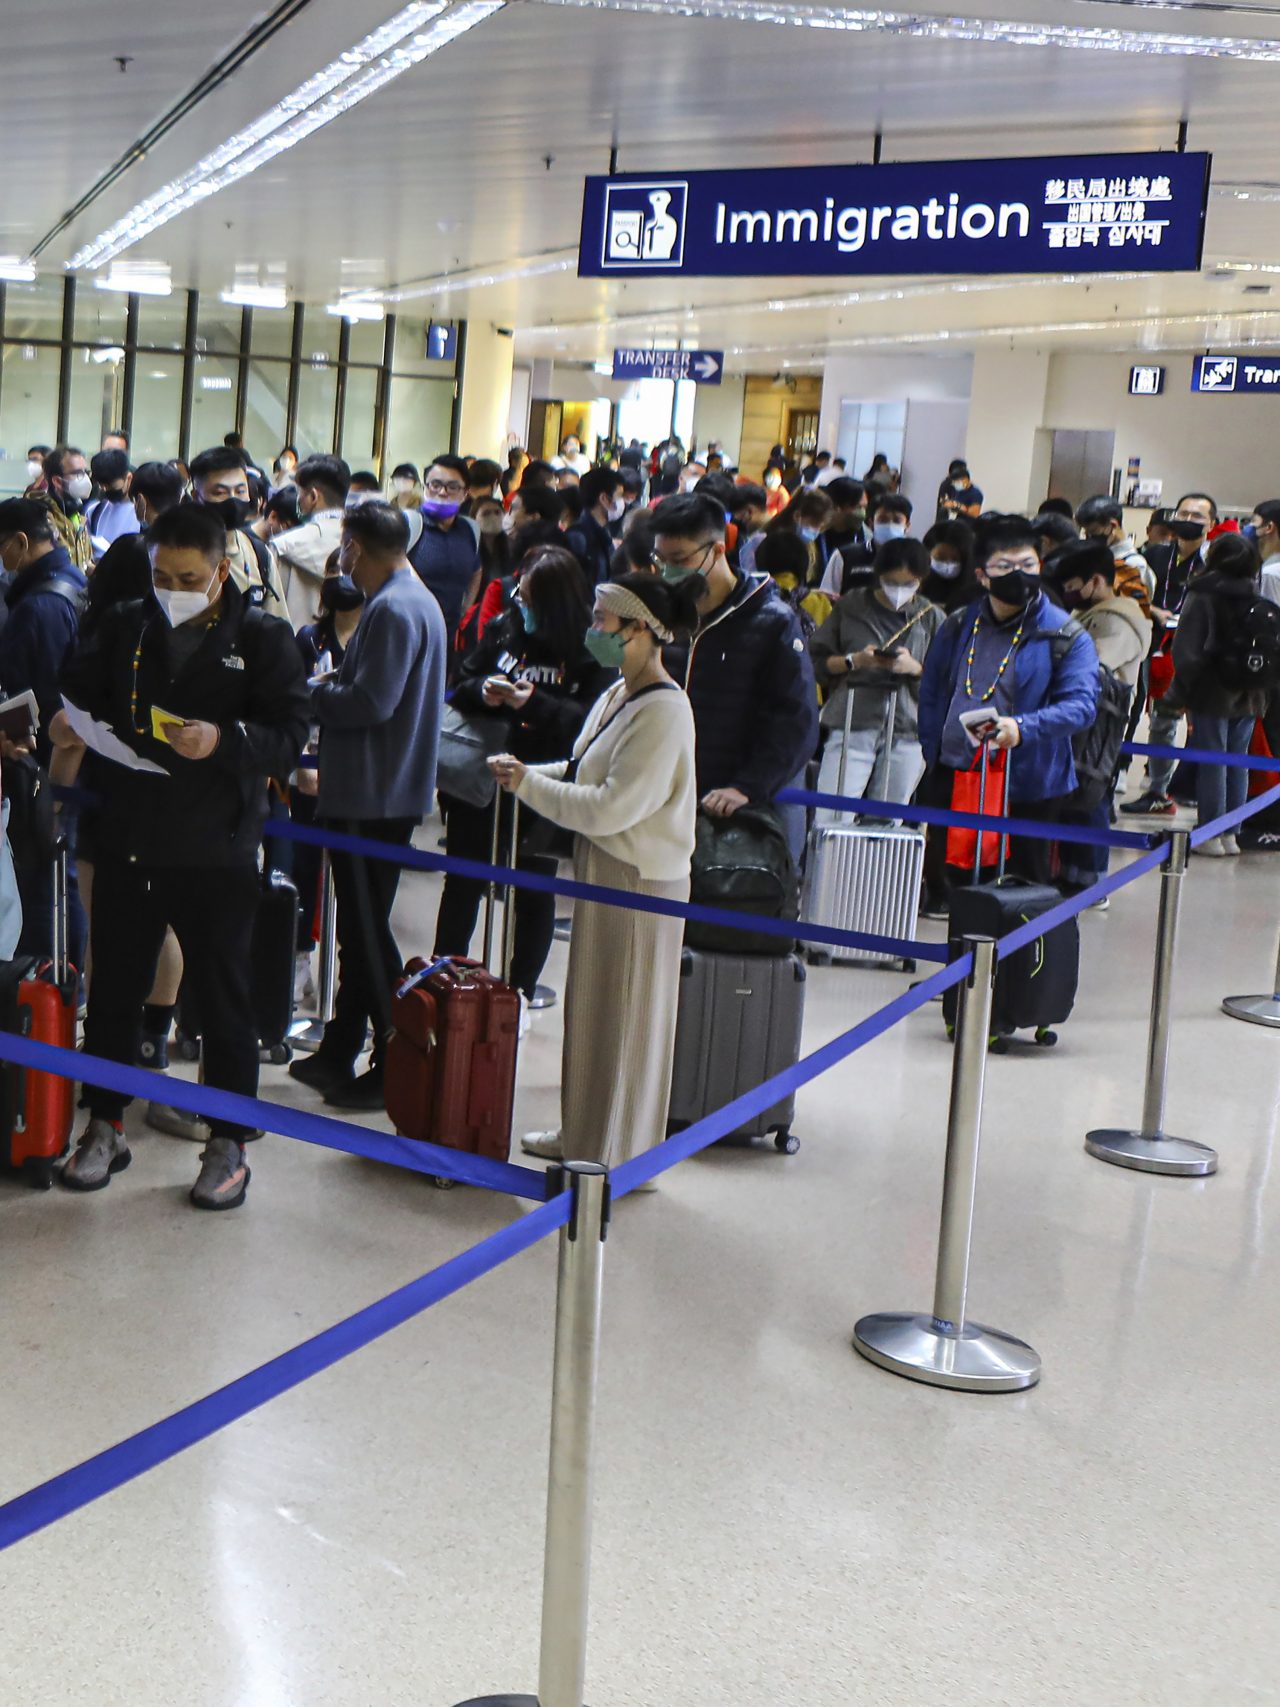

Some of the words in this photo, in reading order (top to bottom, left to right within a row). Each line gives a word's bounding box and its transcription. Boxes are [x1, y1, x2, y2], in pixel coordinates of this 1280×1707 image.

[715, 192, 1030, 253] Immigration
[617, 350, 690, 366] TRANSFER
[652, 366, 690, 379] DESK
